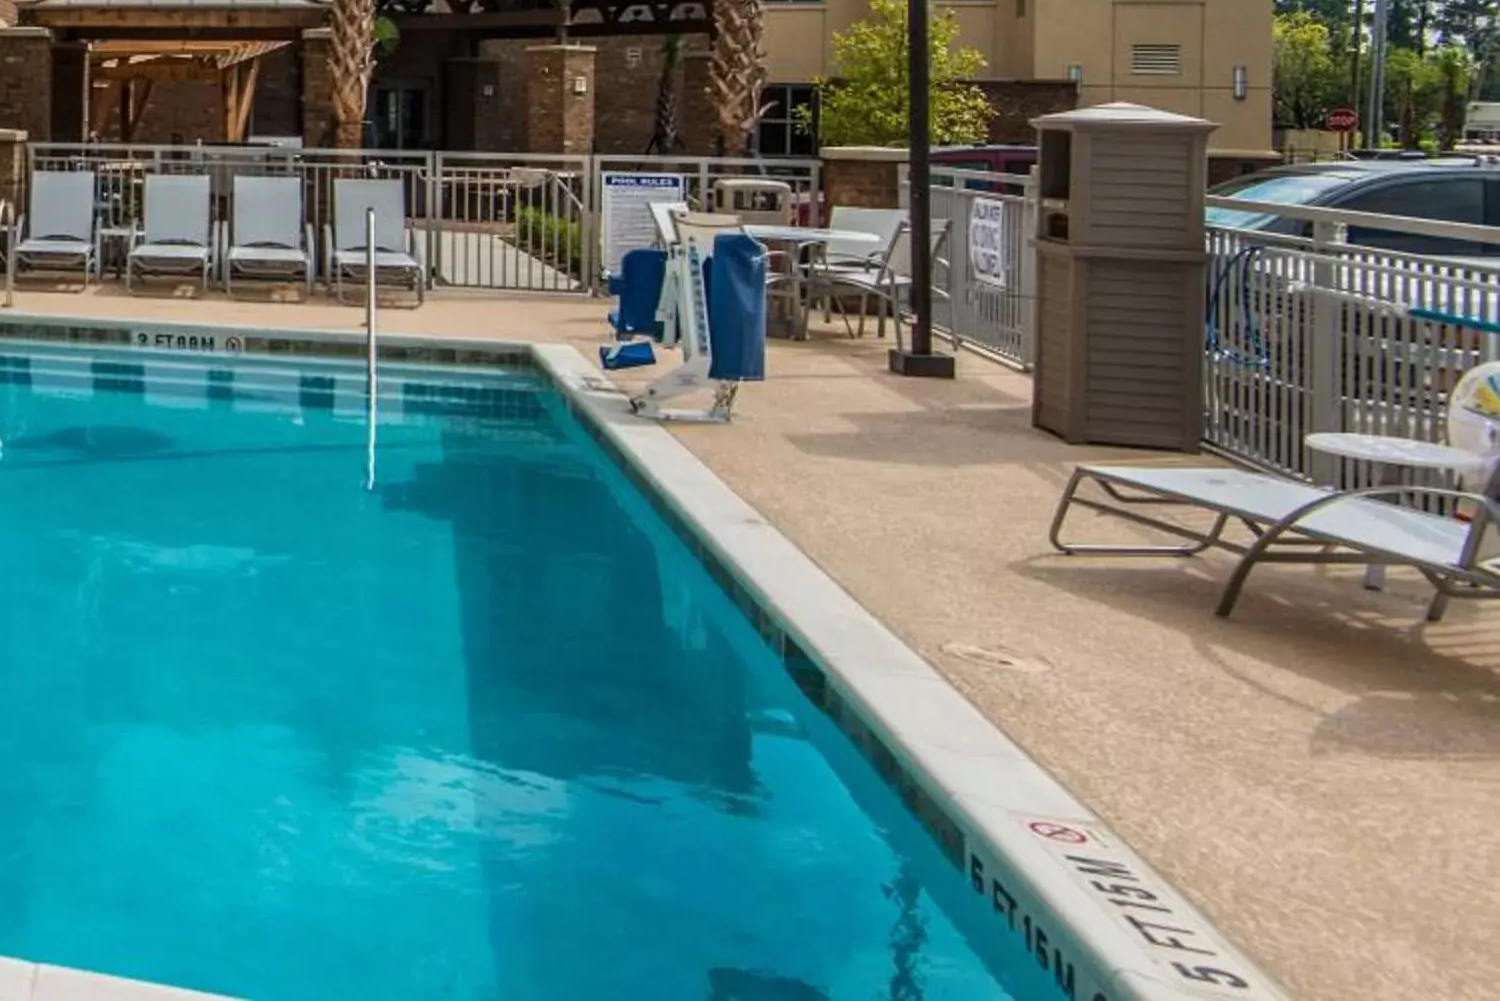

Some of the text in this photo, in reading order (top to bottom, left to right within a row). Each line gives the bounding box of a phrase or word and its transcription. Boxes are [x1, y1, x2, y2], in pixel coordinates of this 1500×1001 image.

[1330, 116, 1355, 125] STOP
[611, 177, 673, 187] POOL RULES
[1124, 915, 1217, 956] FT
[1171, 961, 1249, 988] 5
